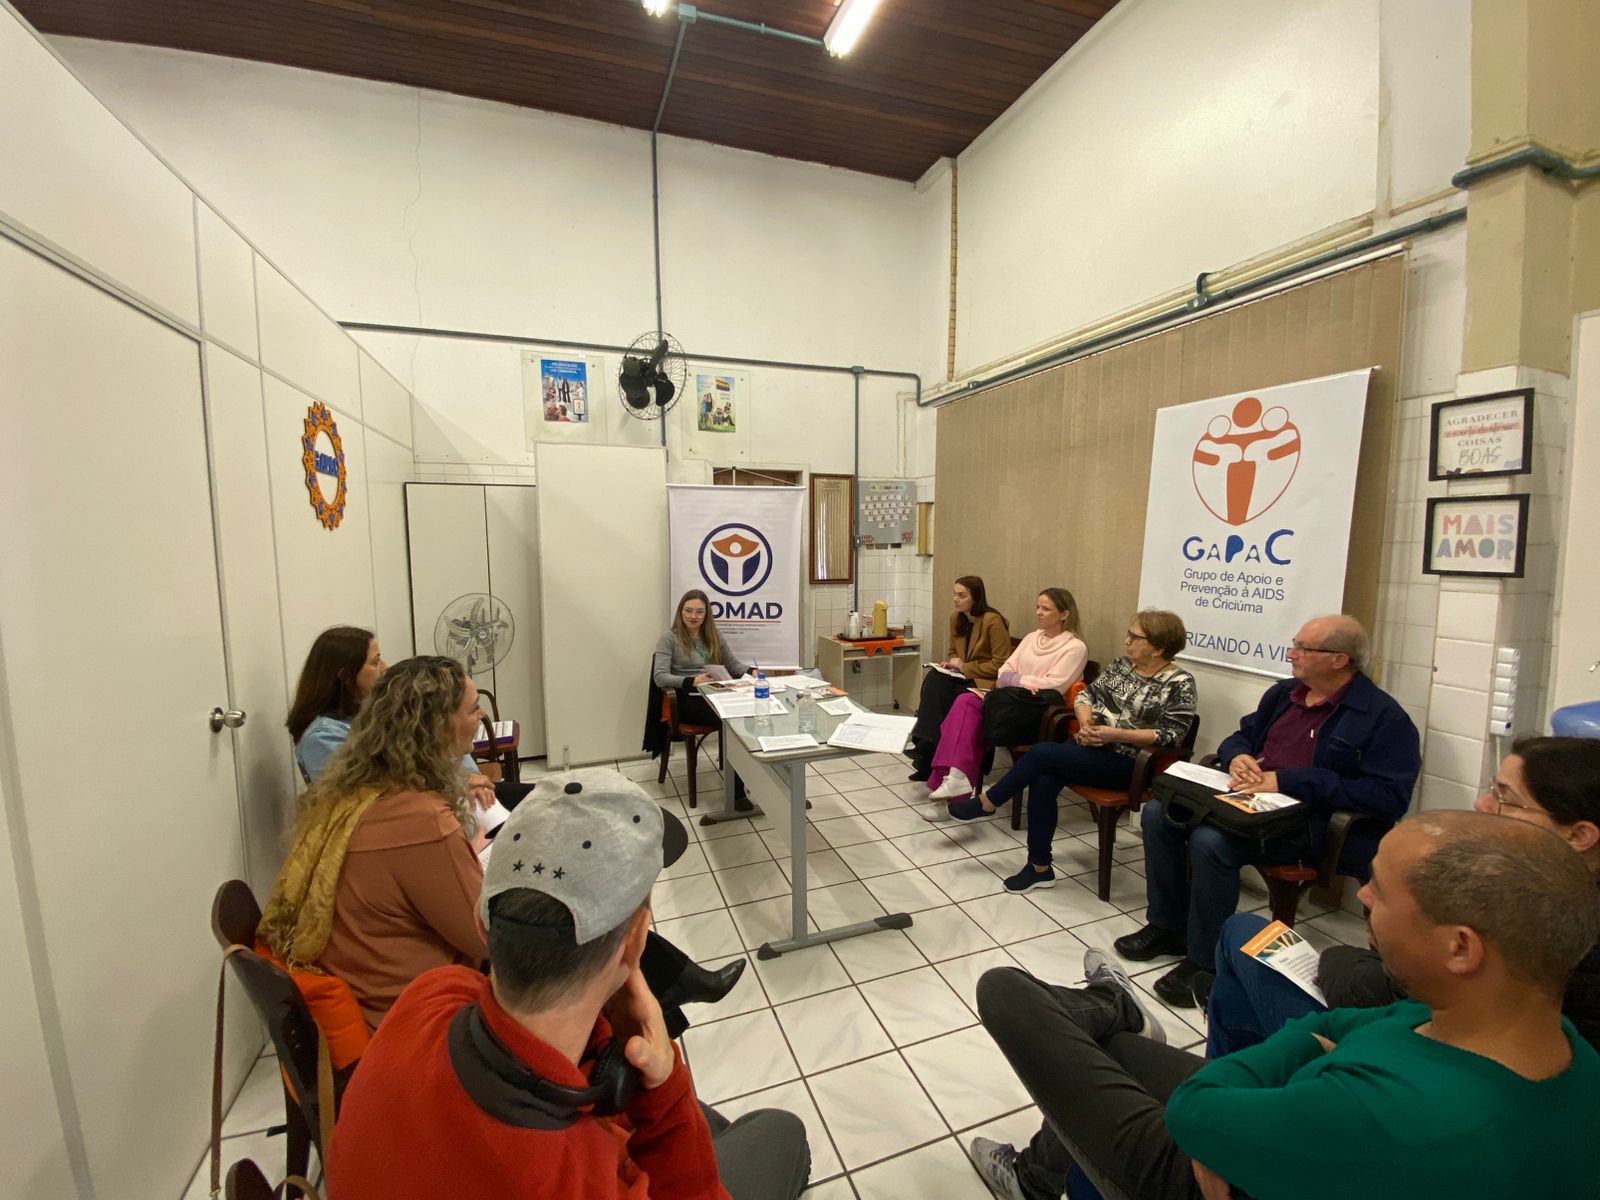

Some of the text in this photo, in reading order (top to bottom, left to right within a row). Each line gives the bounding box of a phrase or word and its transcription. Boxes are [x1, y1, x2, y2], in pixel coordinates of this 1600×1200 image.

[1446, 410, 1518, 426] AGRADECER
[1457, 436, 1502, 447] COISAS
[1459, 446, 1502, 466] BOAS
[1442, 514, 1514, 535] MAIS
[1436, 537, 1515, 560] AMOR
[1184, 568, 1284, 586] Grupo de Apoio e
[1180, 581, 1285, 601] Prevenção à AIDS
[709, 601, 783, 619] OMAD
[1195, 597, 1263, 614] de Criciúma
[1185, 631, 1251, 655] RIZANDO
[1253, 643, 1264, 658] A
